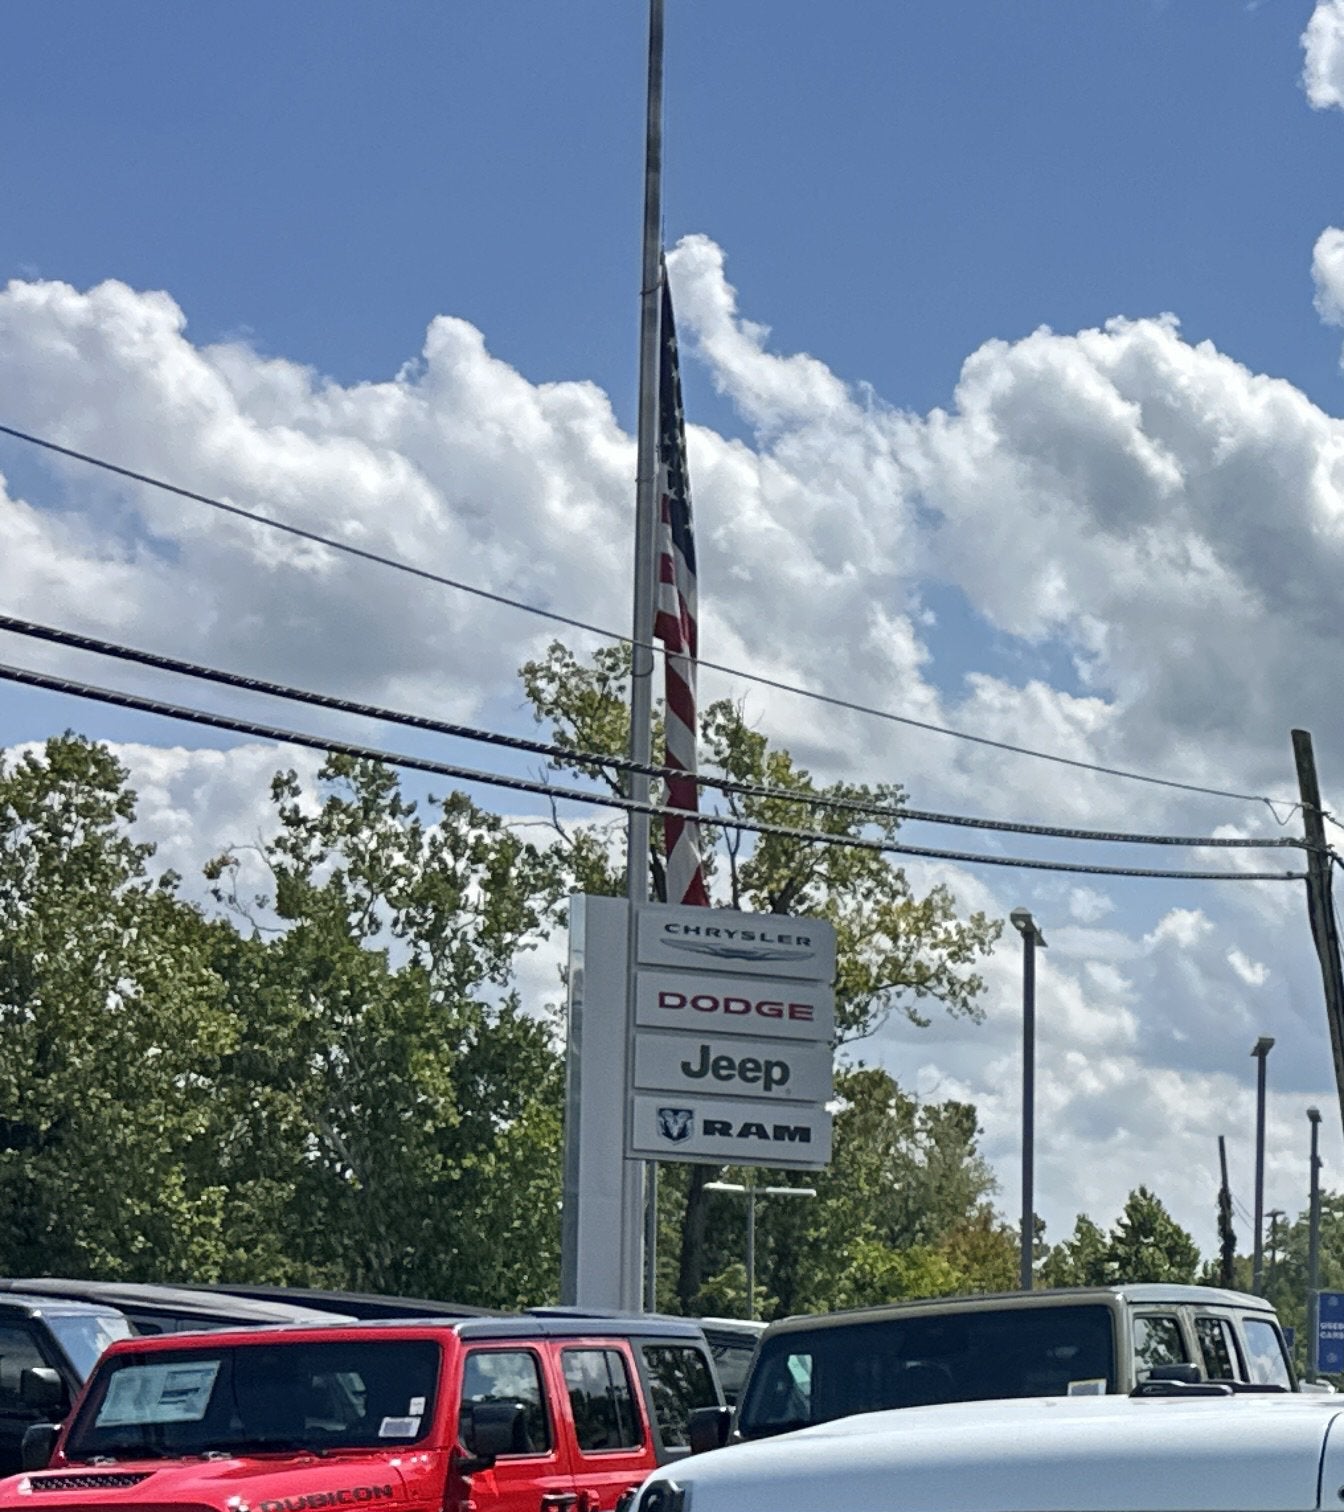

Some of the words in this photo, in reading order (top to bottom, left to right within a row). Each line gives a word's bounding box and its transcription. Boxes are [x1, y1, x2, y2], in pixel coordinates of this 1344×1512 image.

[664, 923, 811, 947] CHRYSLER
[658, 991, 814, 1022] DODGE
[681, 1044, 790, 1092] Jeep
[703, 1119, 811, 1143] RAM
